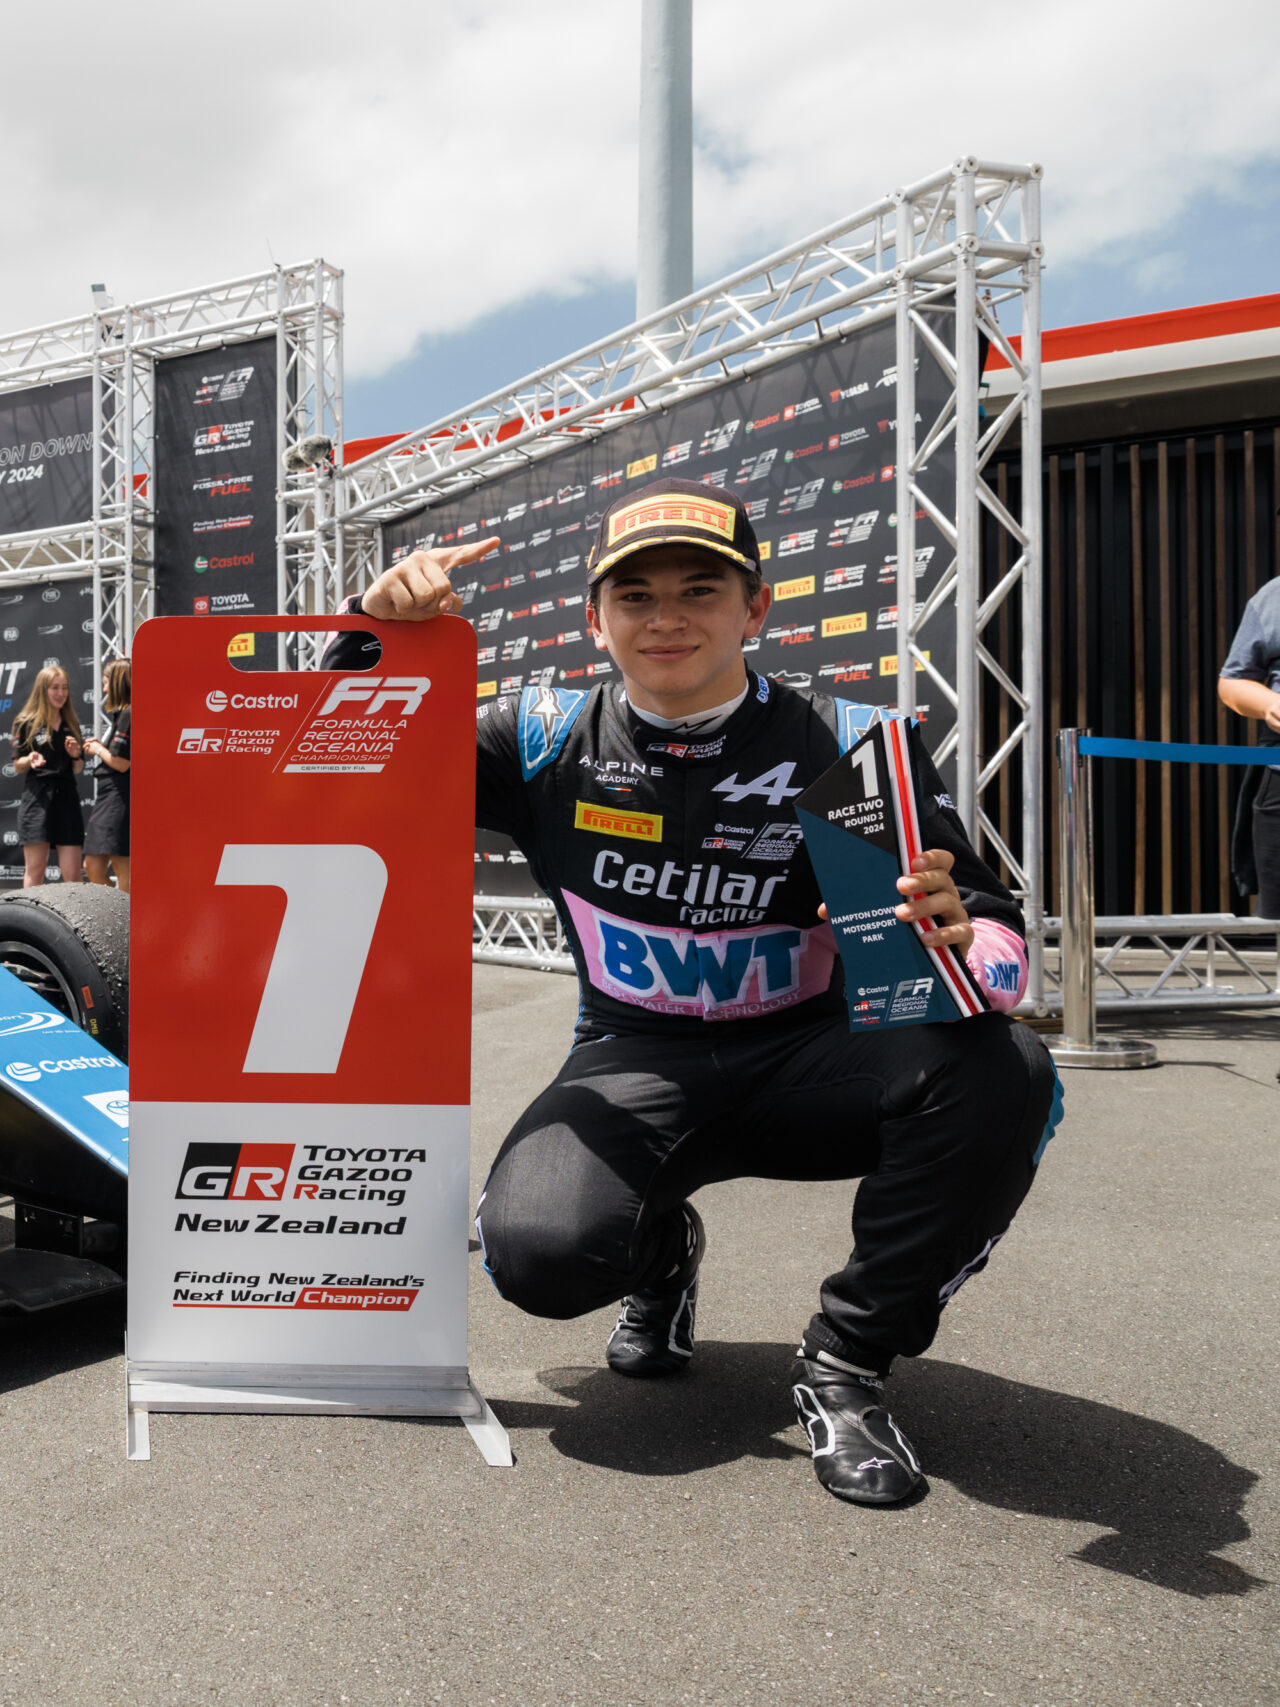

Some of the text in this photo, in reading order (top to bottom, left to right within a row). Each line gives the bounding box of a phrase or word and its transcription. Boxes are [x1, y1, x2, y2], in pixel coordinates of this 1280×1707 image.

[794, 398, 820, 412] TOYOTA
[754, 413, 780, 430] Castrol
[194, 432, 220, 446] GR
[840, 428, 866, 440] TOYOTA
[29, 432, 94, 461] DOWN
[794, 442, 823, 459] Castrol
[7, 464, 44, 484] 2024
[843, 474, 875, 490] Castrol
[210, 483, 252, 497] FUEL
[614, 501, 728, 537] PIRELLI
[209, 553, 254, 569] Castrol
[778, 581, 811, 596] PIRELLI
[211, 593, 249, 605] TOYOTA
[826, 616, 862, 632] PIRELLI
[766, 625, 816, 640] FOSSIL-FREE
[780, 633, 813, 646] FUEL
[818, 663, 873, 676] FOSSIL-FREE
[834, 670, 870, 683] FUEL
[230, 693, 298, 710] Castrol
[317, 676, 431, 716] FR
[310, 719, 408, 729] FORMULA
[227, 737, 275, 745] GAZOO
[230, 729, 280, 737] TOYOTA
[302, 731, 401, 740] REGIONAL
[178, 738, 223, 754] GR
[226, 745, 272, 754] Racing
[297, 742, 394, 752] OCEANIA
[578, 755, 664, 777] ALPINE
[851, 740, 879, 798] 1
[595, 775, 640, 785] ACADEMY
[827, 799, 884, 821] RACE TWO
[583, 809, 655, 836] PIRELLI
[845, 812, 884, 828] ROUND 3
[724, 825, 754, 835] Castrol
[863, 824, 885, 835] 2024
[592, 850, 789, 908] Cetilar
[679, 905, 767, 925] racing
[831, 906, 897, 925] HAMPTON DOWN
[843, 918, 897, 935] MOTORSPORT
[862, 933, 884, 943] PARK
[595, 916, 805, 1007] BWT
[866, 985, 889, 994] Castrol
[895, 977, 934, 998] FR
[631, 996, 686, 1015] WATER
[692, 992, 801, 1019] TECHNOLOGY
[892, 1000, 928, 1008] REGIONAL
[894, 995, 930, 1003] FORMULA
[891, 1005, 927, 1013] OCEANIA
[39, 1055, 123, 1073] Castrol
[303, 1145, 427, 1163] TOYOTA
[181, 1165, 285, 1198] GR
[298, 1165, 413, 1182] GAZOO
[293, 1184, 406, 1206] Racing
[174, 1213, 407, 1235] New Zealand
[173, 1271, 425, 1287] Finding New Zealand's
[173, 1289, 410, 1308] Next World Champion
